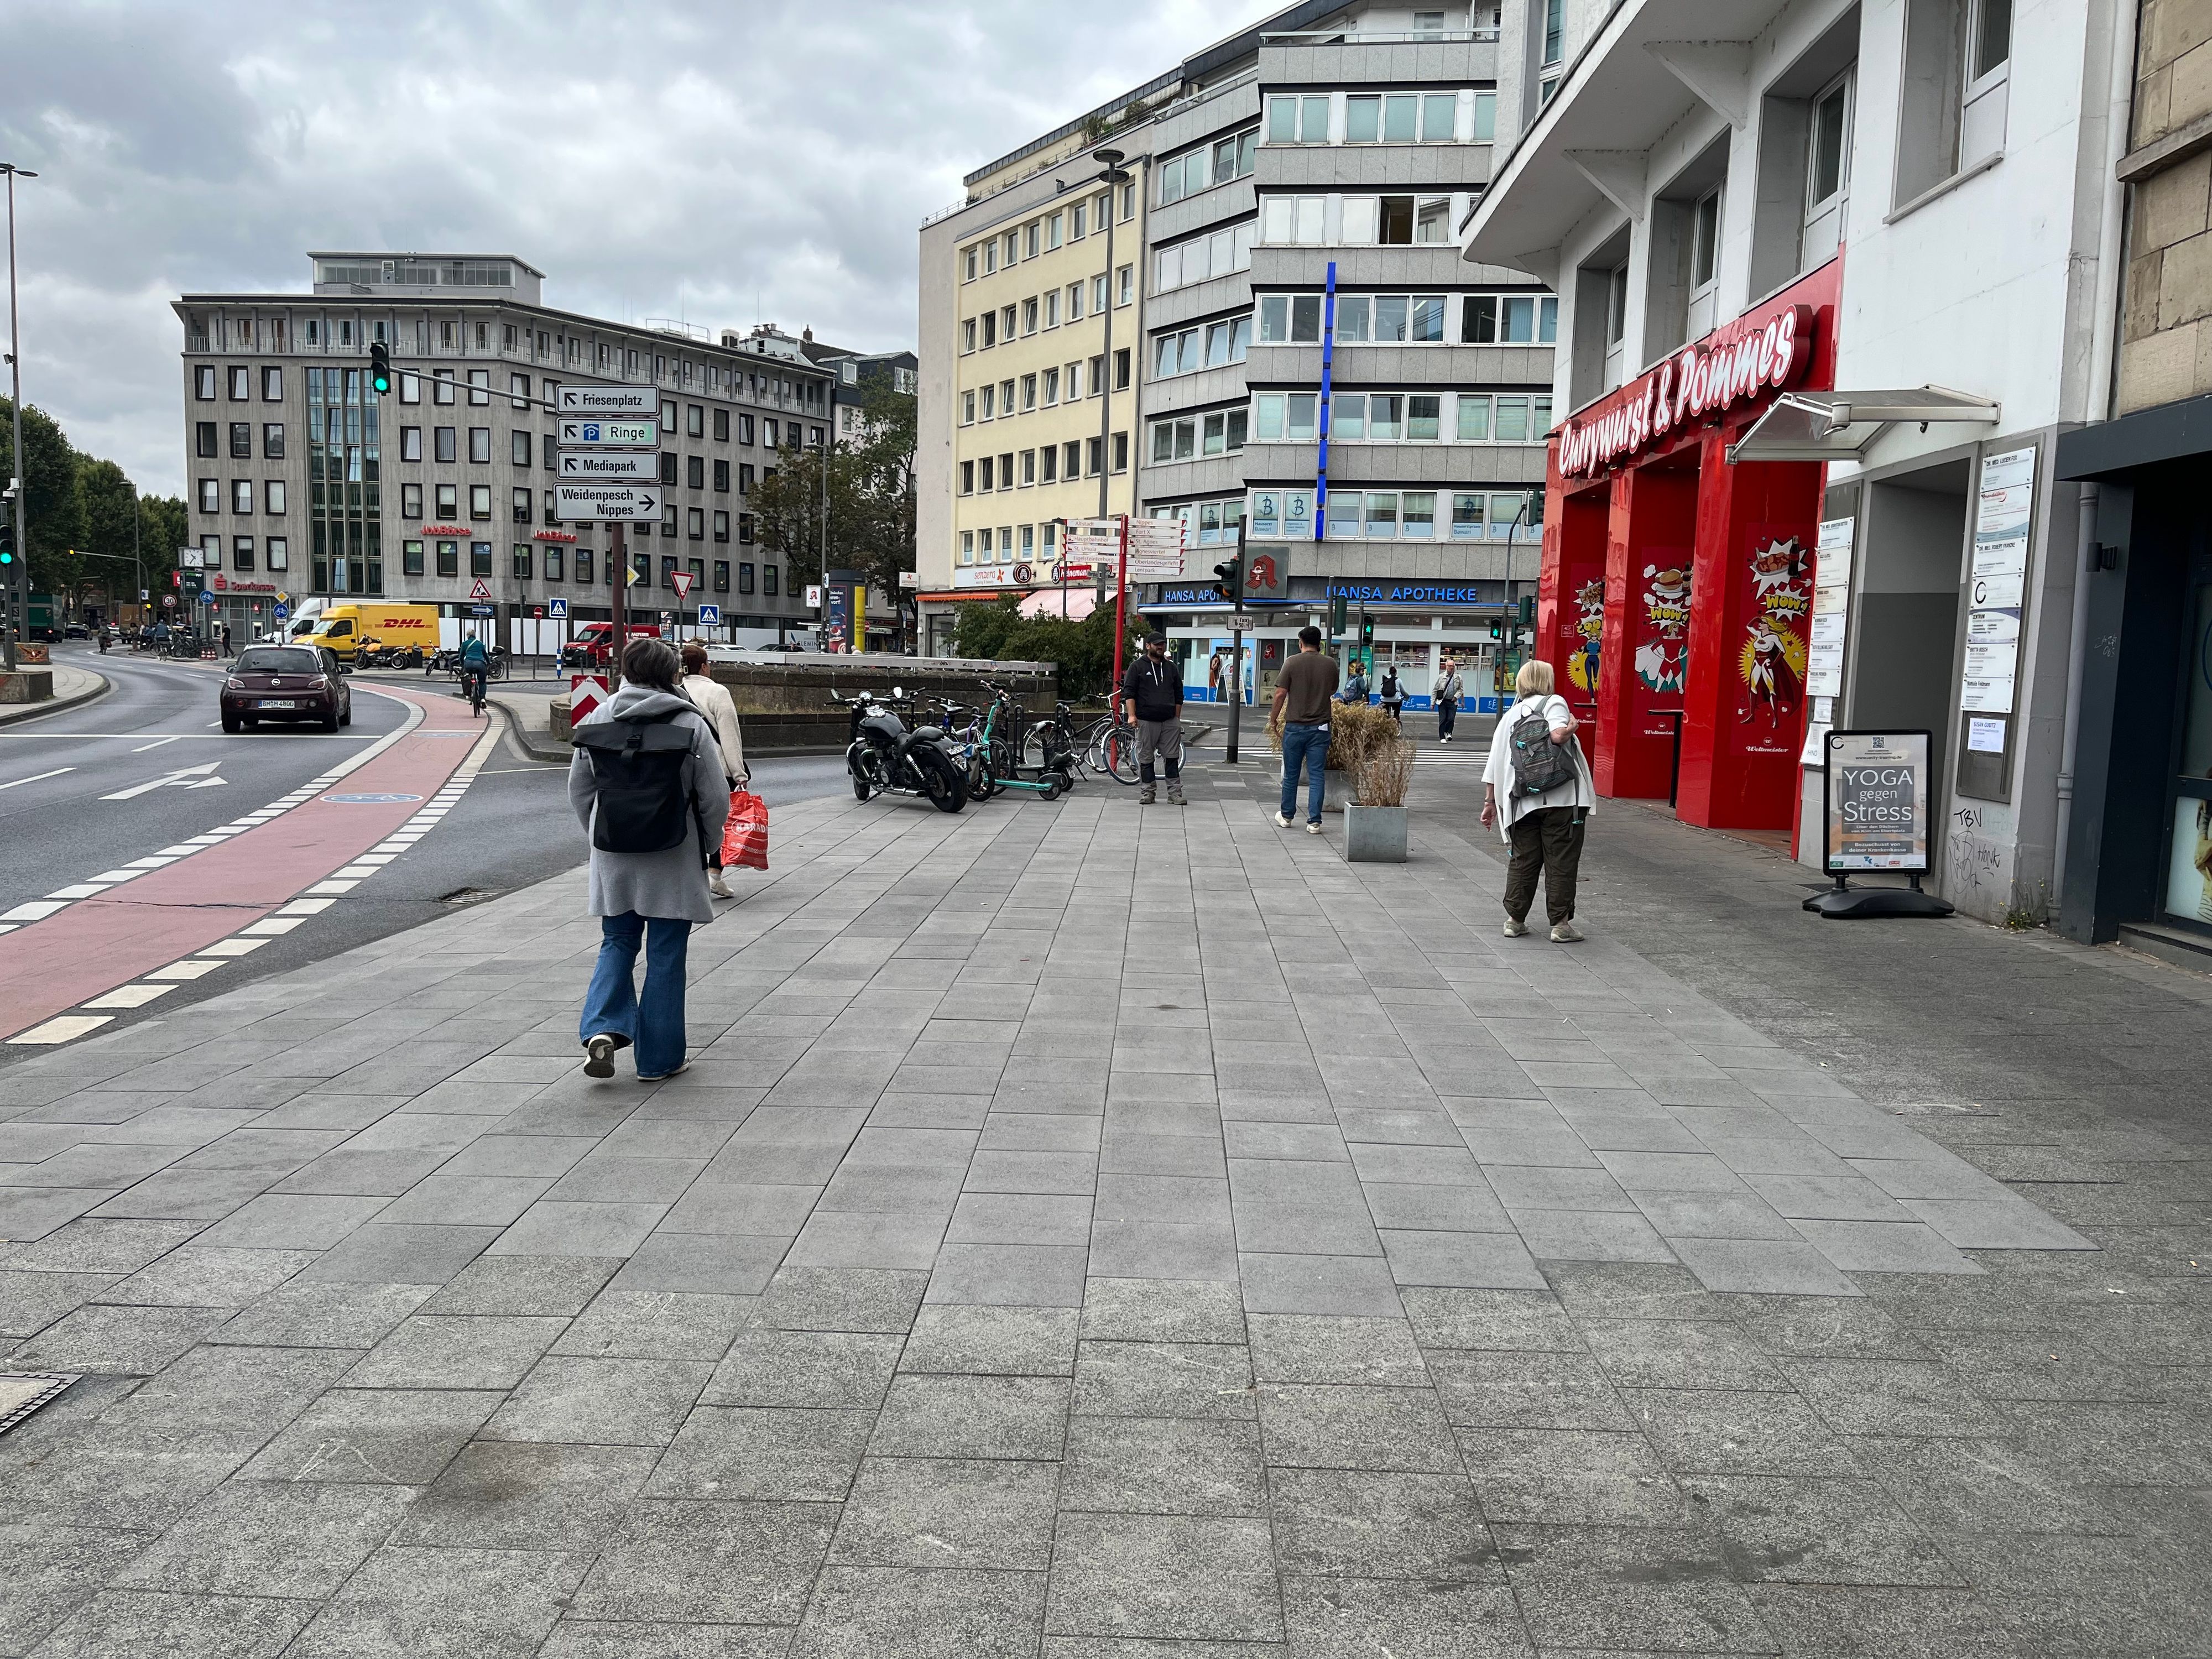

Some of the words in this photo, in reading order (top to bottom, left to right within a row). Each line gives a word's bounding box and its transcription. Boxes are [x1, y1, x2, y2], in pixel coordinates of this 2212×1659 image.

[1559, 373, 1653, 478] Currywurst
[1655, 359, 1672, 436] &
[1674, 305, 1796, 425] Pommes
[583, 394, 642, 408] Friesenplatz
[588, 429, 596, 440] P
[611, 426, 645, 440] Ringe
[583, 460, 636, 473] Mediapark
[561, 488, 633, 502] Weidenpesch
[597, 504, 634, 517] Nippes
[421, 525, 472, 536] JobBörse
[231, 582, 275, 592] Sparkasse
[1391, 587, 1477, 601] APOTHEKE
[1165, 591, 1194, 602] HANSA
[1198, 589, 1220, 602] APOT
[1766, 594, 1808, 612] WOW!
[1650, 607, 1688, 623] WOW!
[383, 619, 425, 628] DHL
[1577, 618, 1601, 634] COO
[1844, 769, 1913, 786] YOGA
[1859, 790, 1897, 801] gegen
[1844, 801, 1912, 822] Stress
[1953, 807, 1982, 827] TBV
